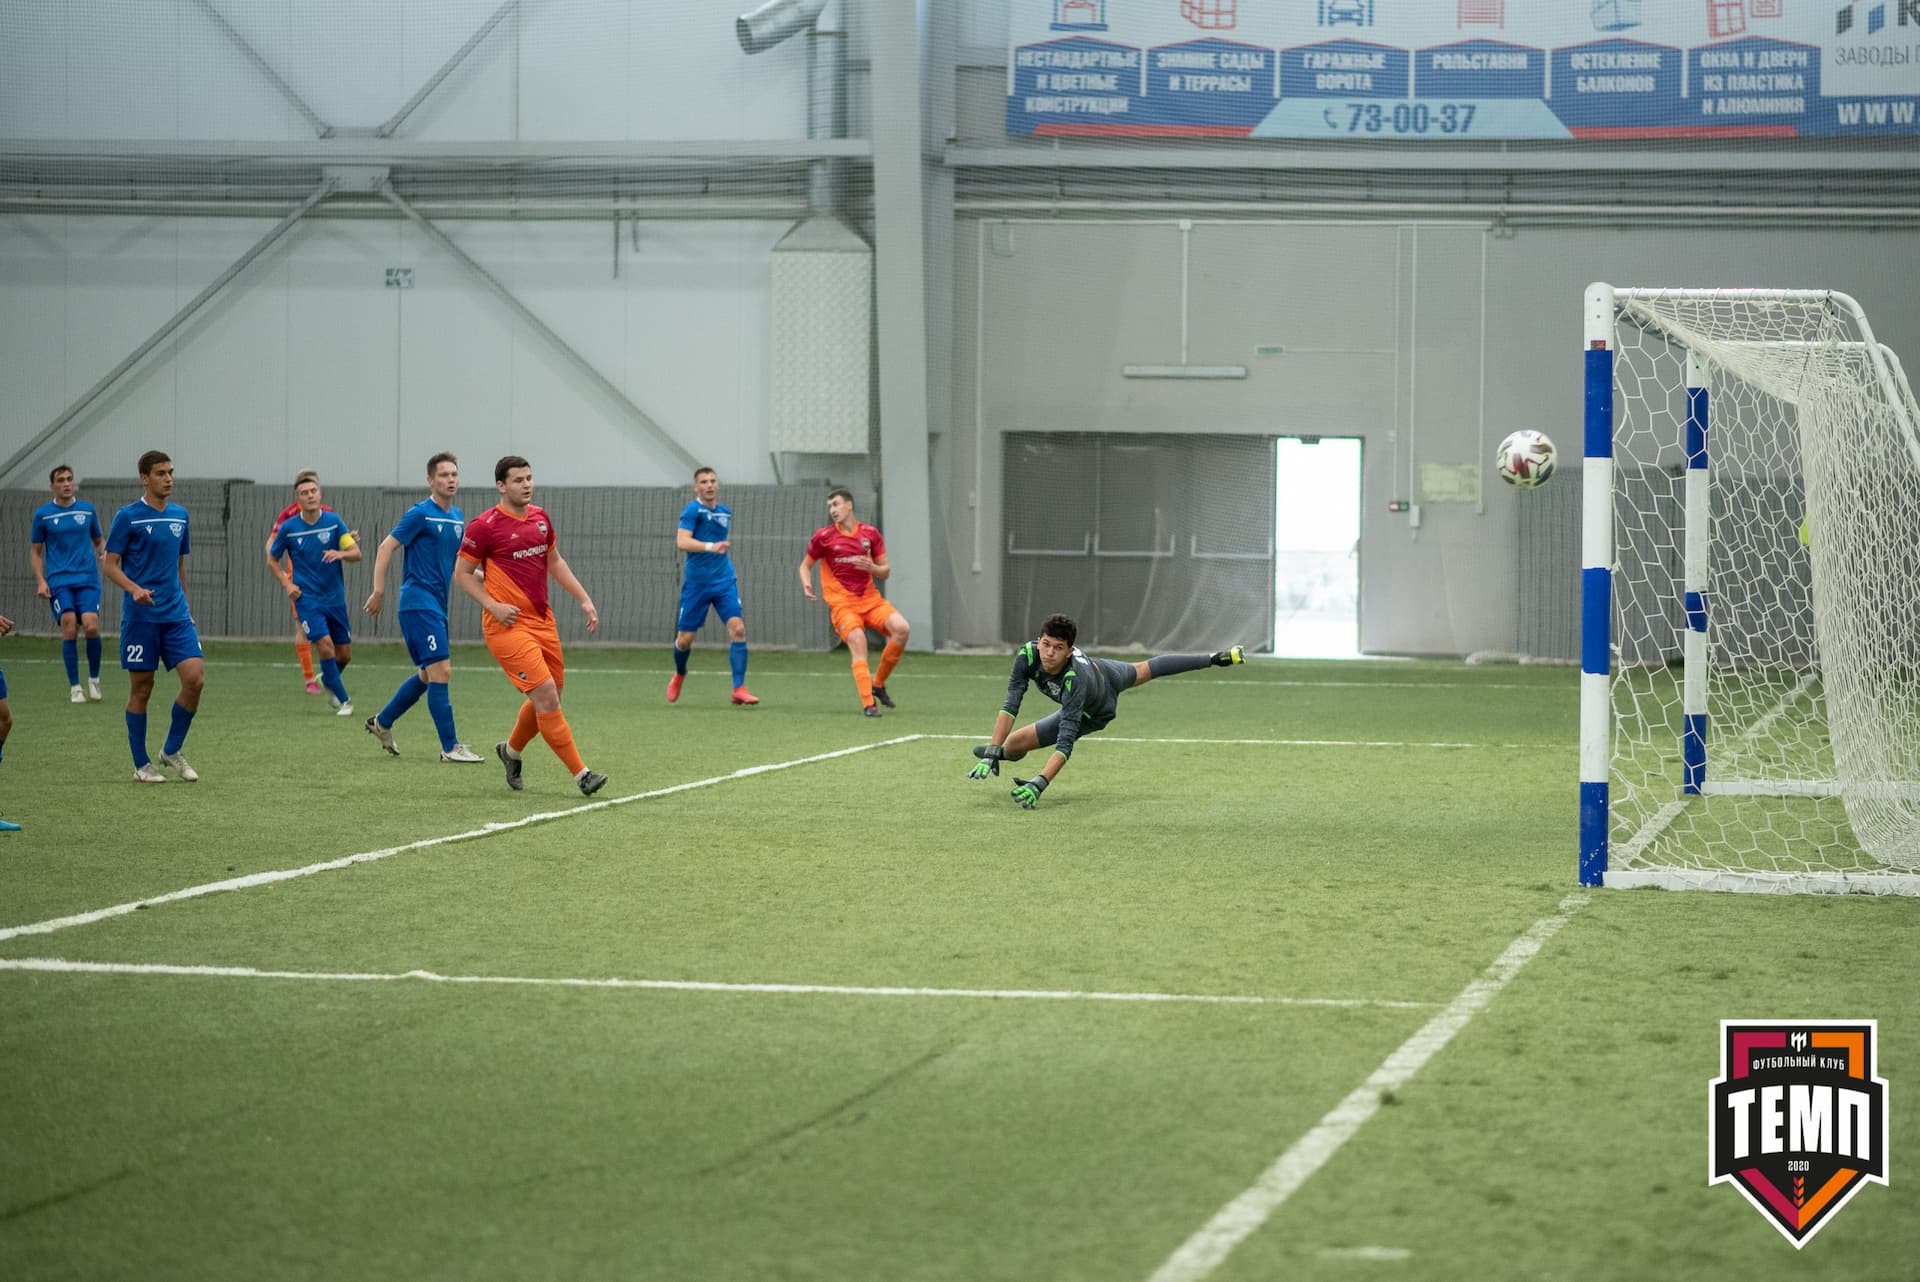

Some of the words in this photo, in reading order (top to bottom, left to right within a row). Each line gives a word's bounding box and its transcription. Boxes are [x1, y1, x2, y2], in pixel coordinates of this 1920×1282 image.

[1157, 52, 1216, 69] ЗИМНИЕ
[1220, 52, 1264, 71] САДЫ
[1303, 53, 1386, 70] ГАРАЖНЫЕ
[1432, 53, 1528, 70] РОЛЬСТАВНИ
[1570, 52, 1661, 70] ОСТЕКЛЕНИЕ
[1701, 51, 1740, 68] ОКНА
[1744, 51, 1754, 68] И
[1758, 50, 1807, 69] ДВЕРИ
[1835, 45, 1909, 68] ЗАВОДЫ
[1051, 74, 1119, 92] ЦВЕТНЫЕ
[1168, 74, 1180, 91] И
[1184, 75, 1252, 92] ТЕРРАСЫ
[1315, 74, 1373, 90] ВОРОТА
[1577, 75, 1656, 92] БАЛКОНОВ
[1703, 74, 1723, 91] ИЗ
[1727, 74, 1804, 91] ПЛАСТИКА
[1703, 98, 1713, 115] И
[1346, 103, 1477, 133] 73-00-37
[427, 635, 438, 651] 3
[126, 645, 144, 663] 22
